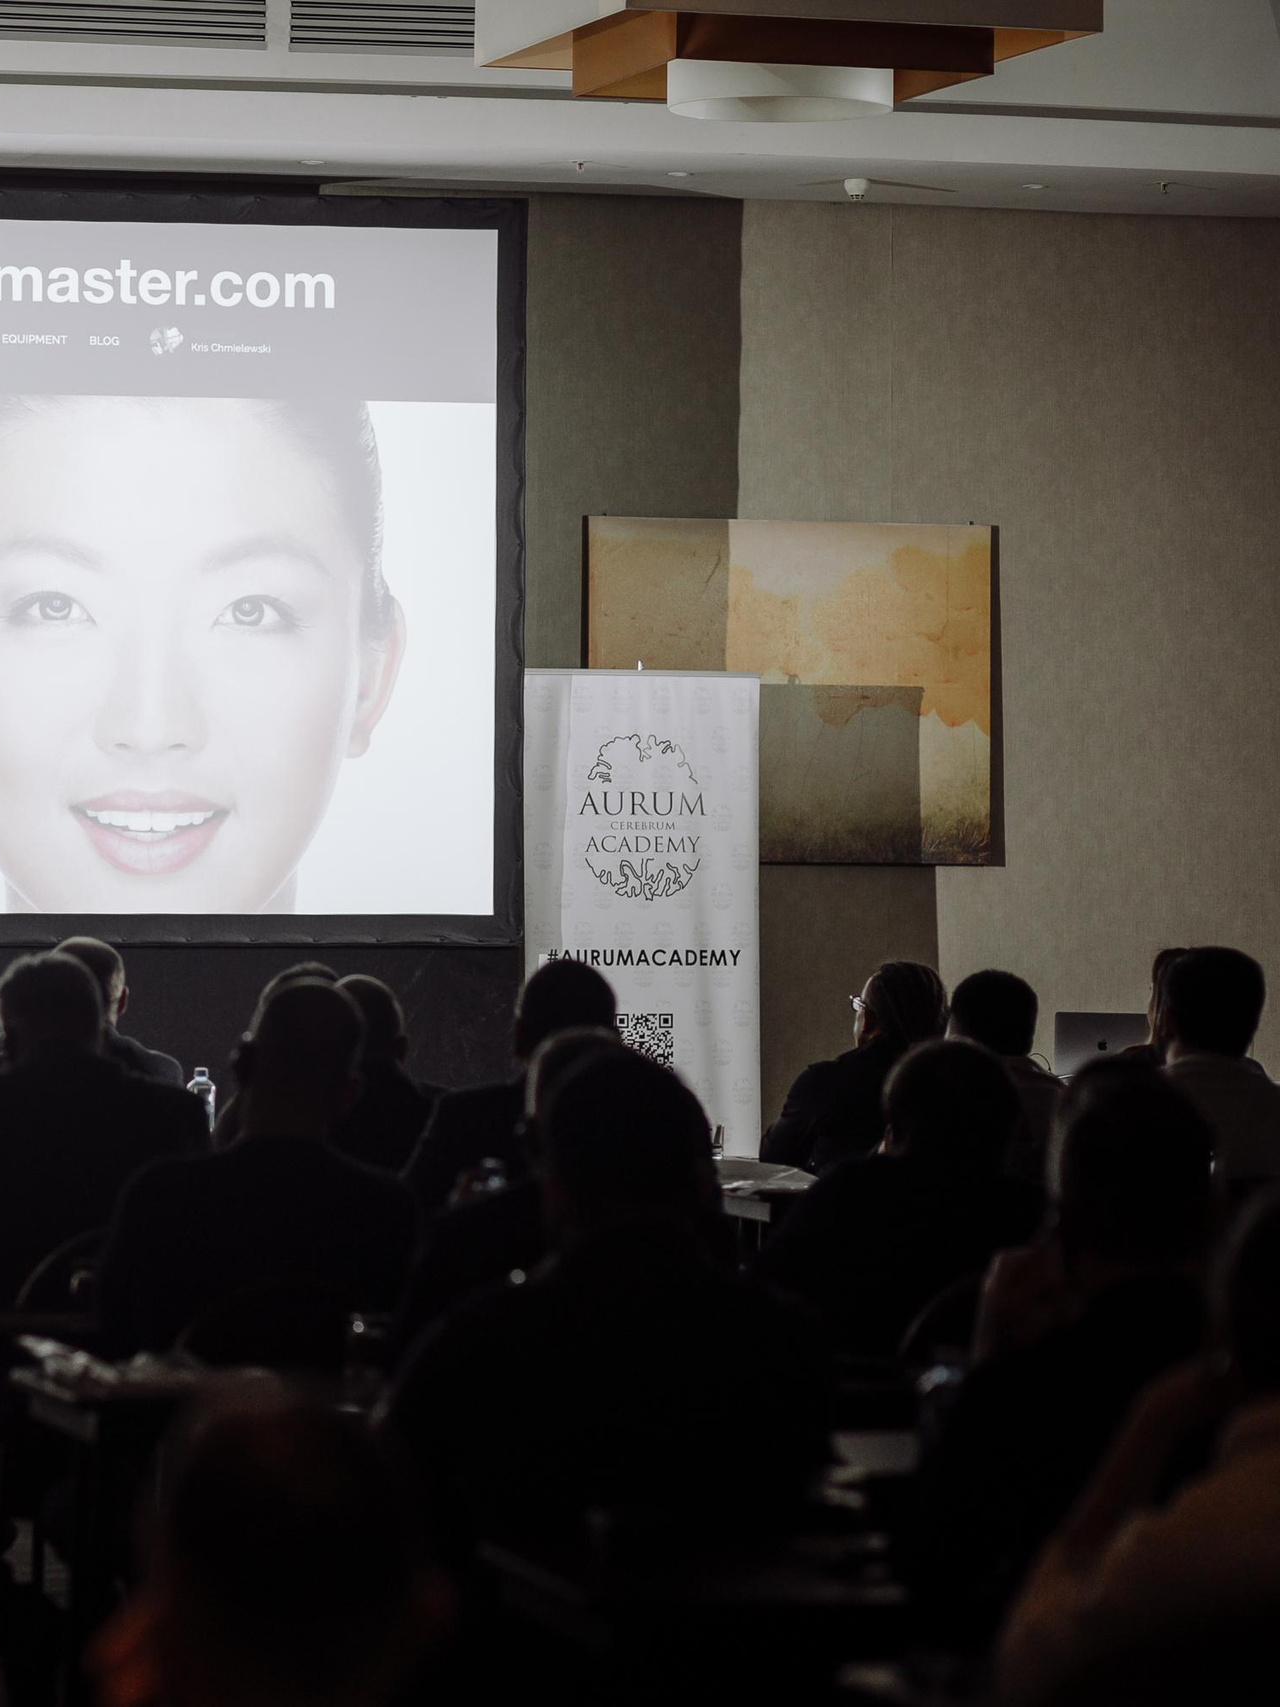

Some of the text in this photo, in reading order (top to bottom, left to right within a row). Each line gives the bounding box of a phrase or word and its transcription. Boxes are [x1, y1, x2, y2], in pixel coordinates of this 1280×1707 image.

[1, 333, 68, 346] EQUIPMENT
[89, 335, 120, 347] BLOG
[191, 342, 271, 354] Kris Chmielewski
[579, 791, 707, 817] AURUM
[610, 821, 676, 831] CEREBRUM
[585, 835, 700, 854] ACADEMY
